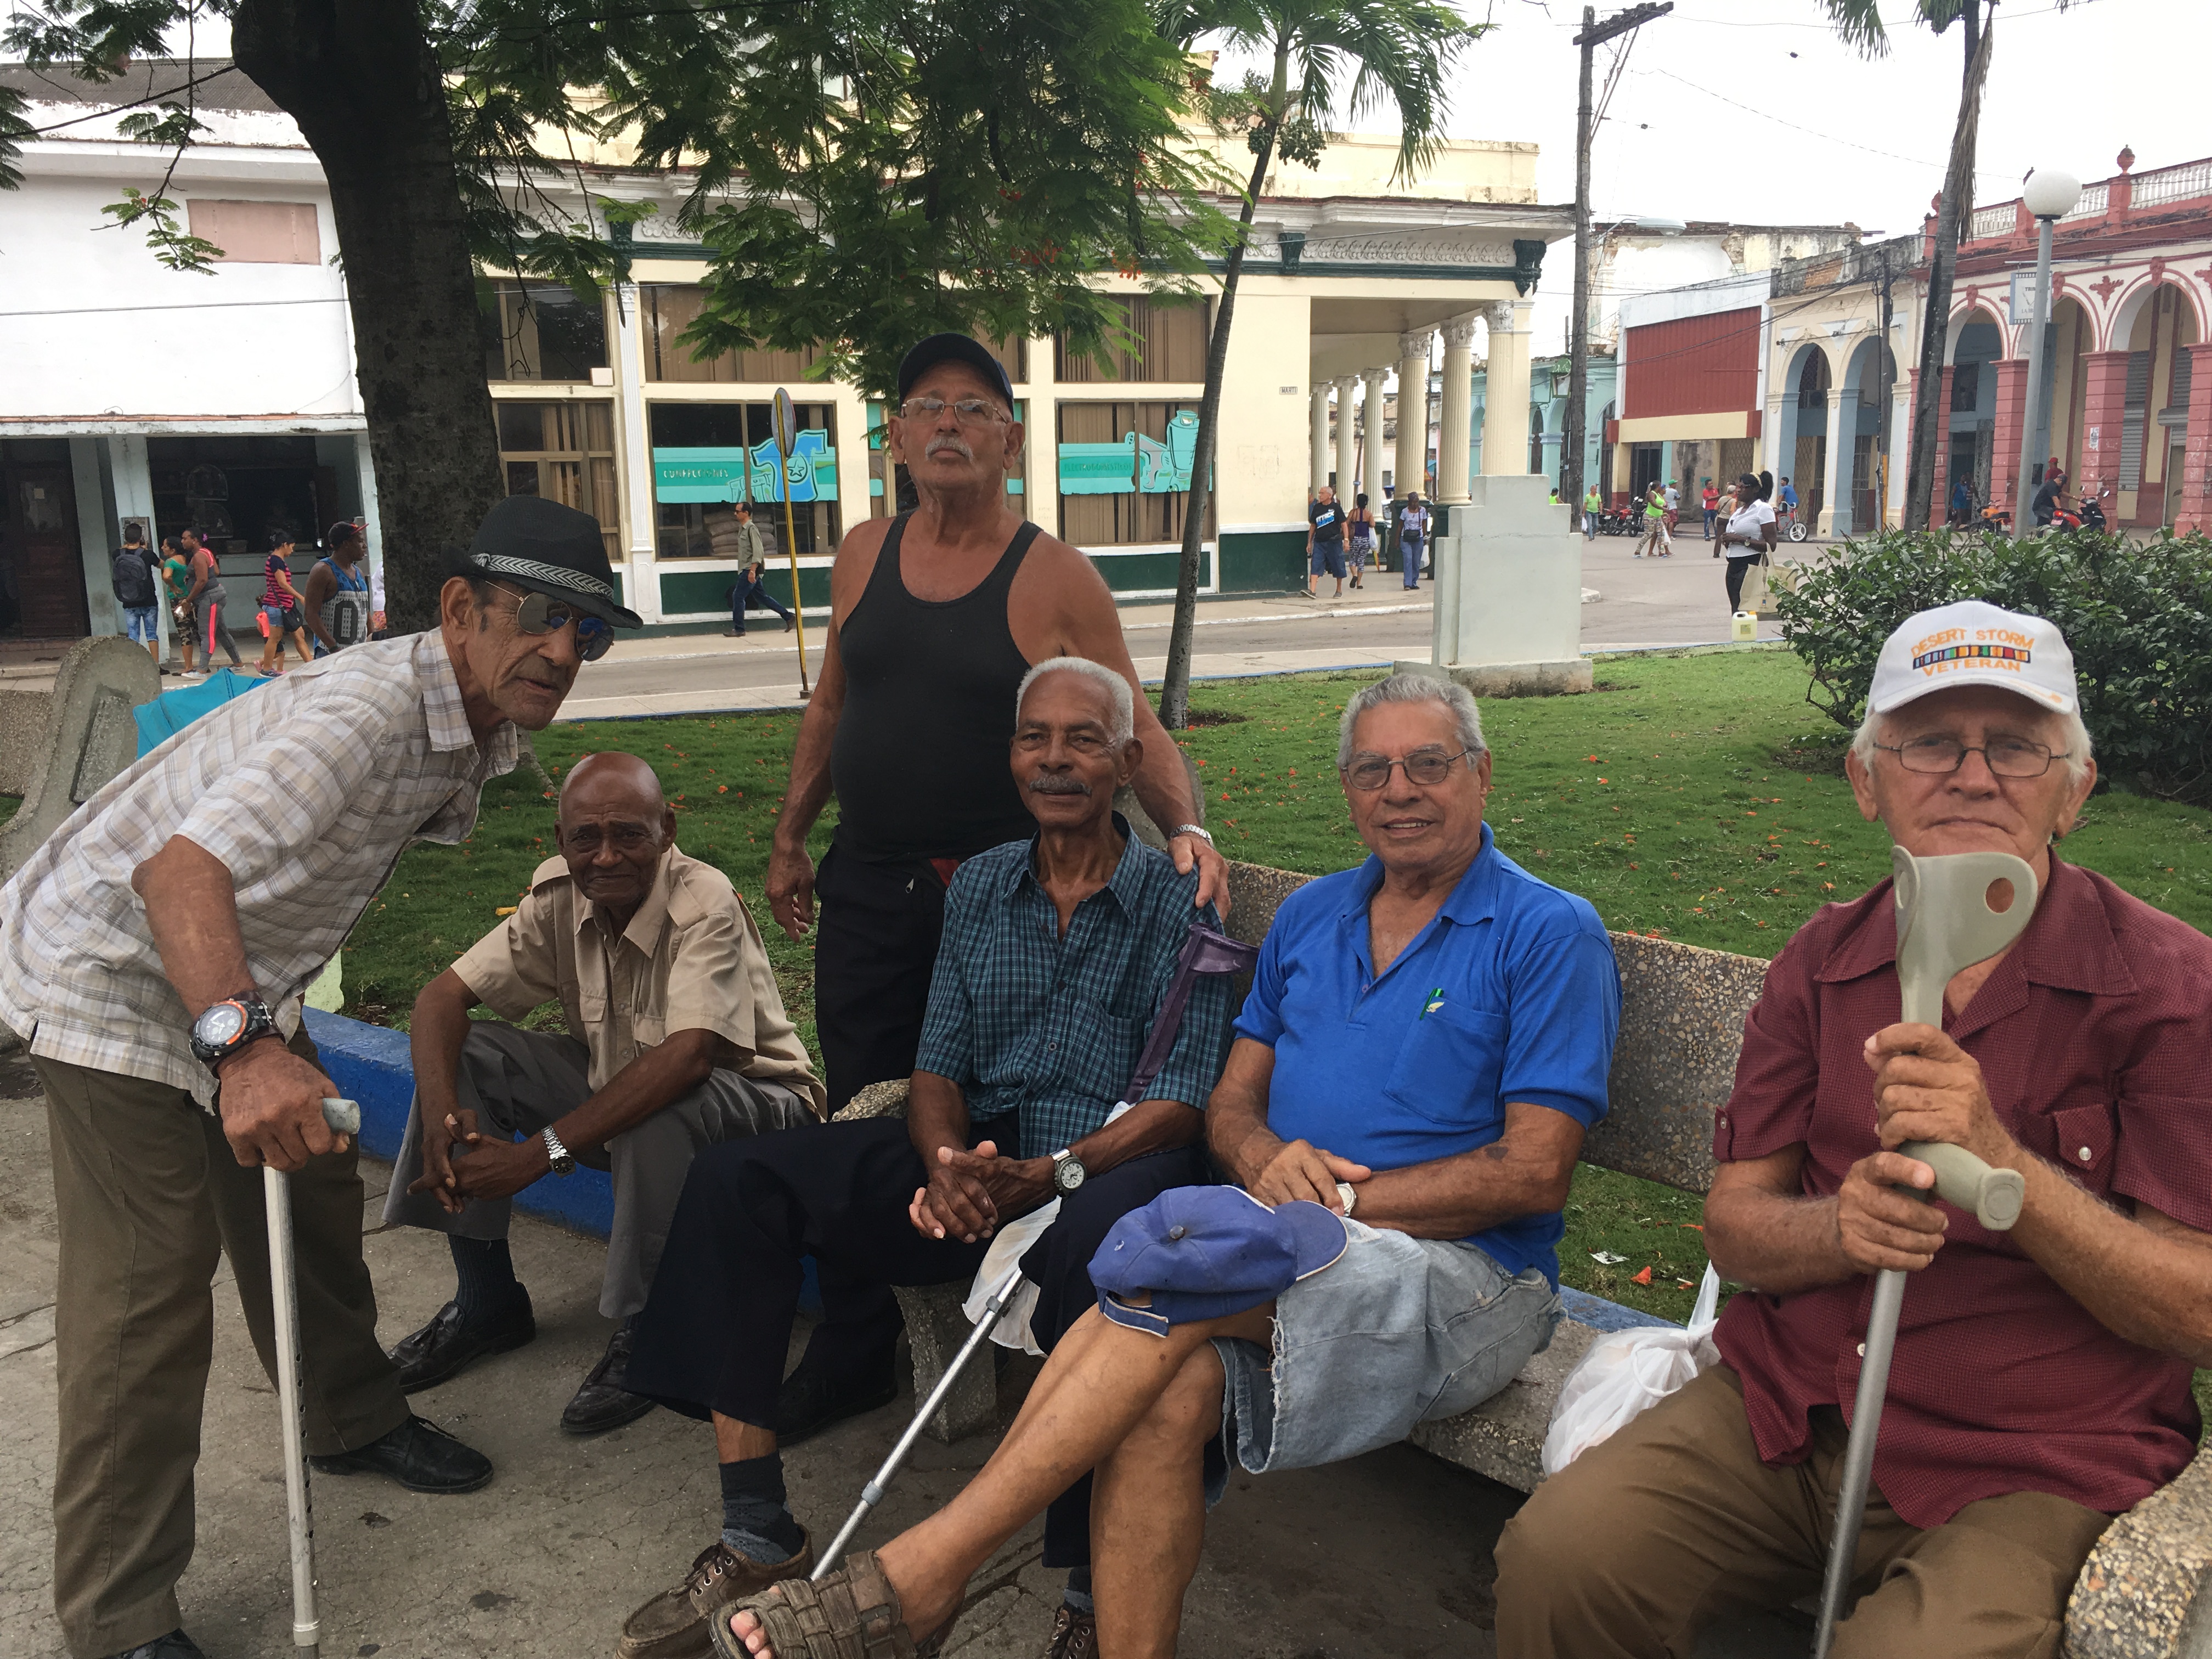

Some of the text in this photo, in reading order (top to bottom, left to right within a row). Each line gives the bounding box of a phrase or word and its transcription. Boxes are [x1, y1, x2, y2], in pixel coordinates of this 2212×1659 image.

[1910, 628, 2035, 658] DESERT STORM
[1921, 658, 2021, 677] VETERAN
